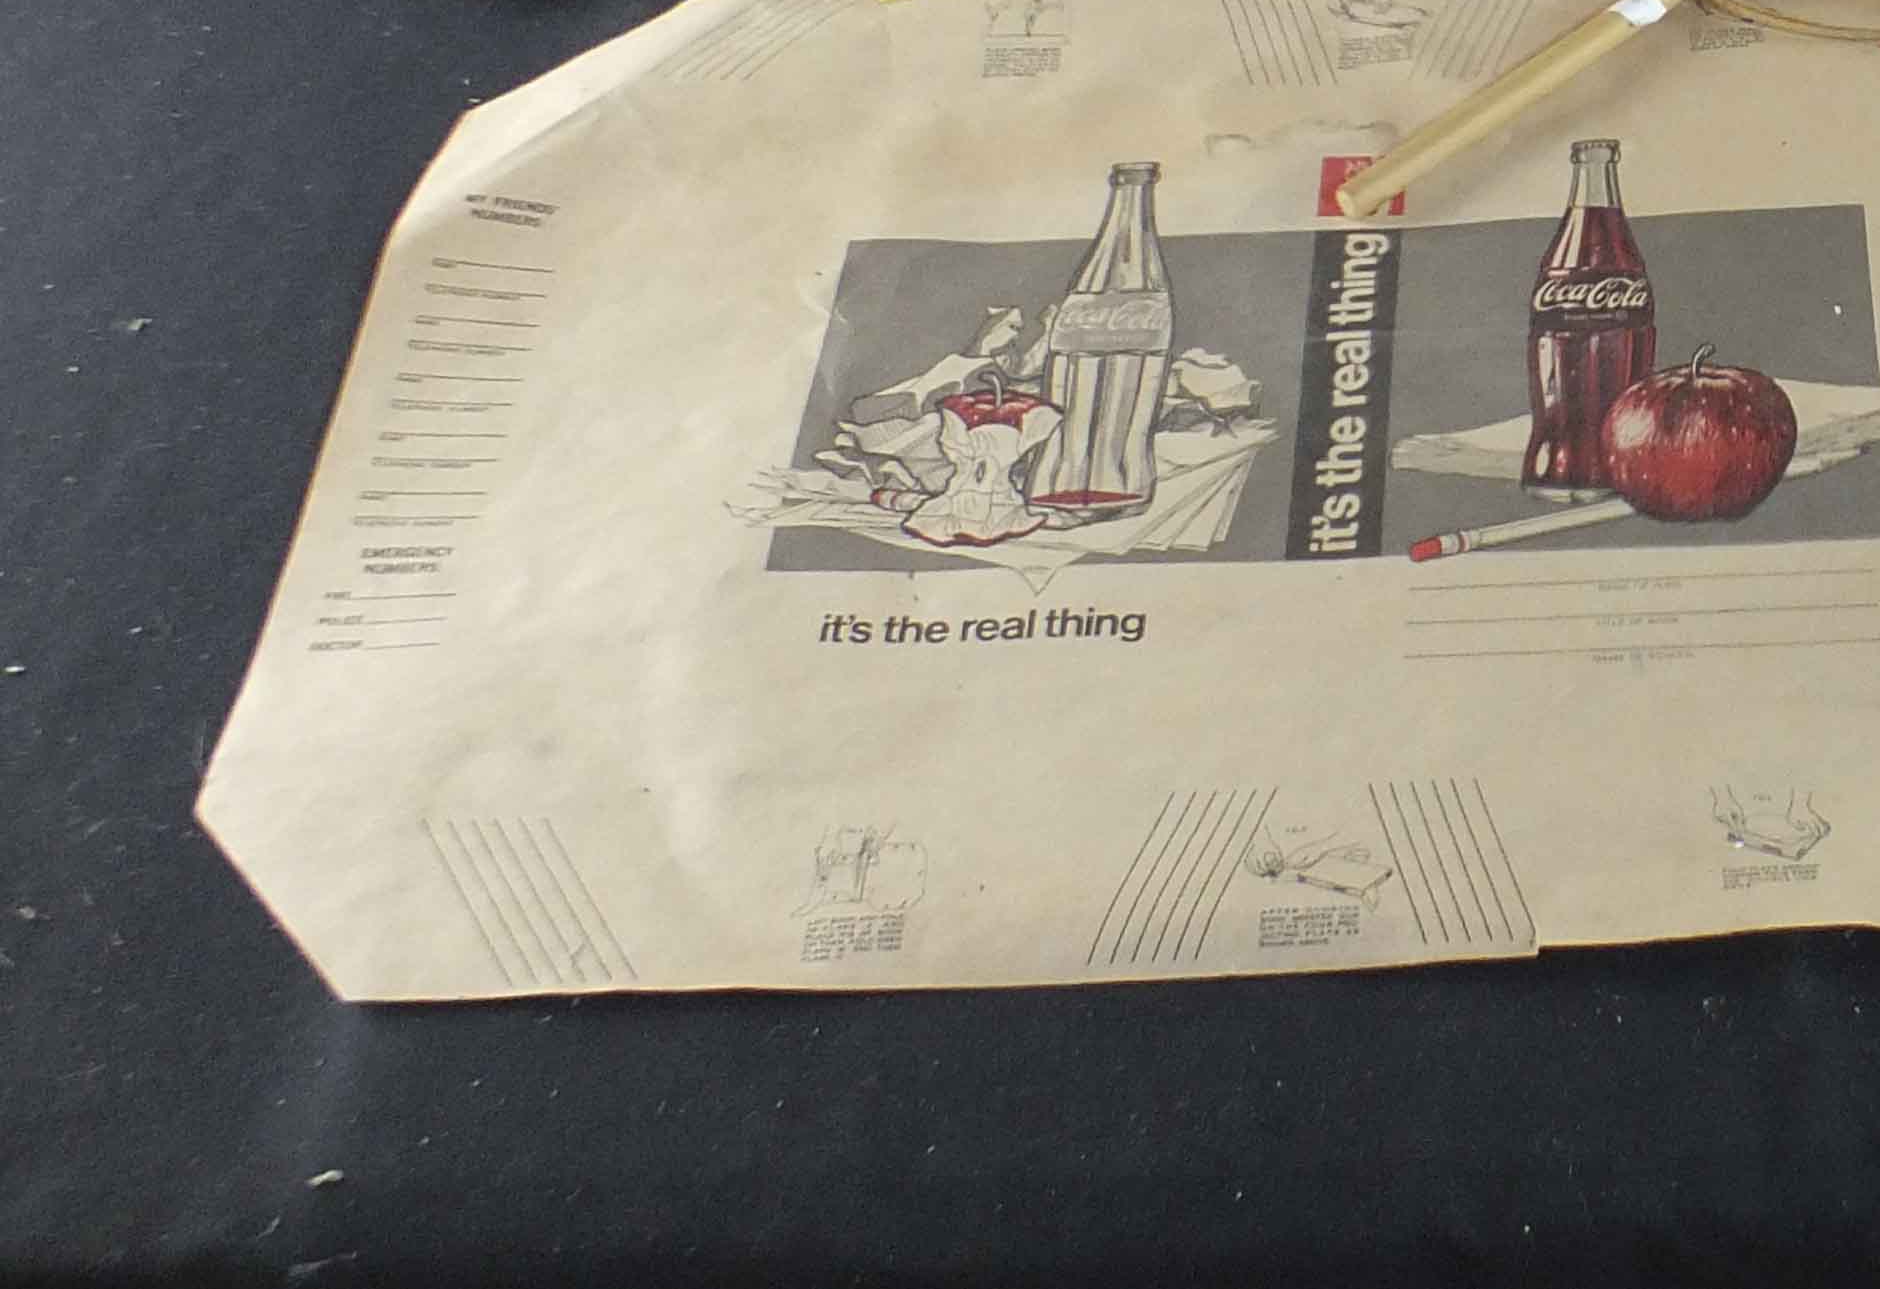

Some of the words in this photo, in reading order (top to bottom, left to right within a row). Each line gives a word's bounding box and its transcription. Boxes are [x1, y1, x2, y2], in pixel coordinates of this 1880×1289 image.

[1327, 231, 1390, 326] thing
[1325, 329, 1372, 408] real
[1314, 415, 1367, 487] the
[1309, 493, 1361, 553] it's
[818, 613, 874, 644] it's
[883, 614, 950, 644] the
[959, 610, 1034, 642] real
[1045, 607, 1148, 642] thing
